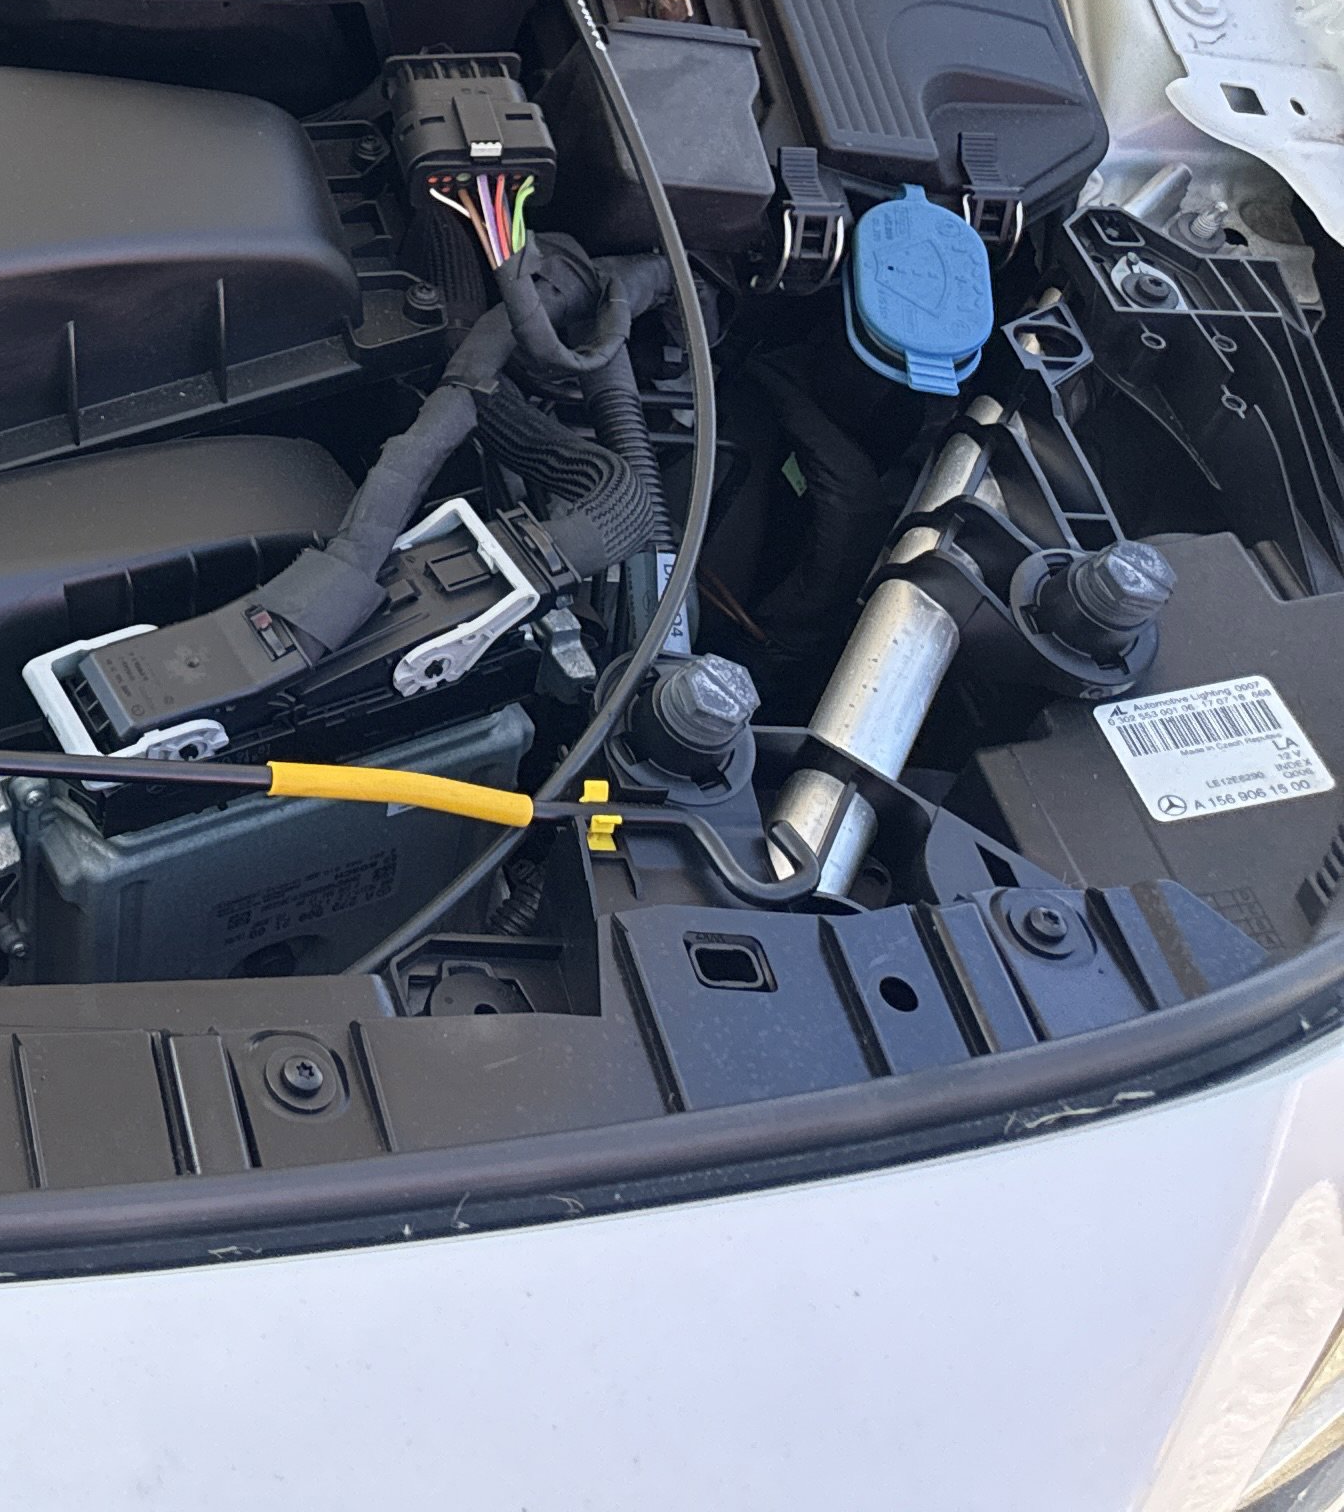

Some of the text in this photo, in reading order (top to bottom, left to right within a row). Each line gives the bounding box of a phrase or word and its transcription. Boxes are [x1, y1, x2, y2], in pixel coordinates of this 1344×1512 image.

[1133, 695, 1189, 712] Automotive
[1190, 687, 1232, 703] Lighting
[1235, 681, 1260, 692] 0007
[1140, 710, 1158, 721] 553
[1272, 737, 1298, 751] LA
[1275, 759, 1312, 772] INDEX
[1194, 779, 1311, 811] A 156 906 15 00
